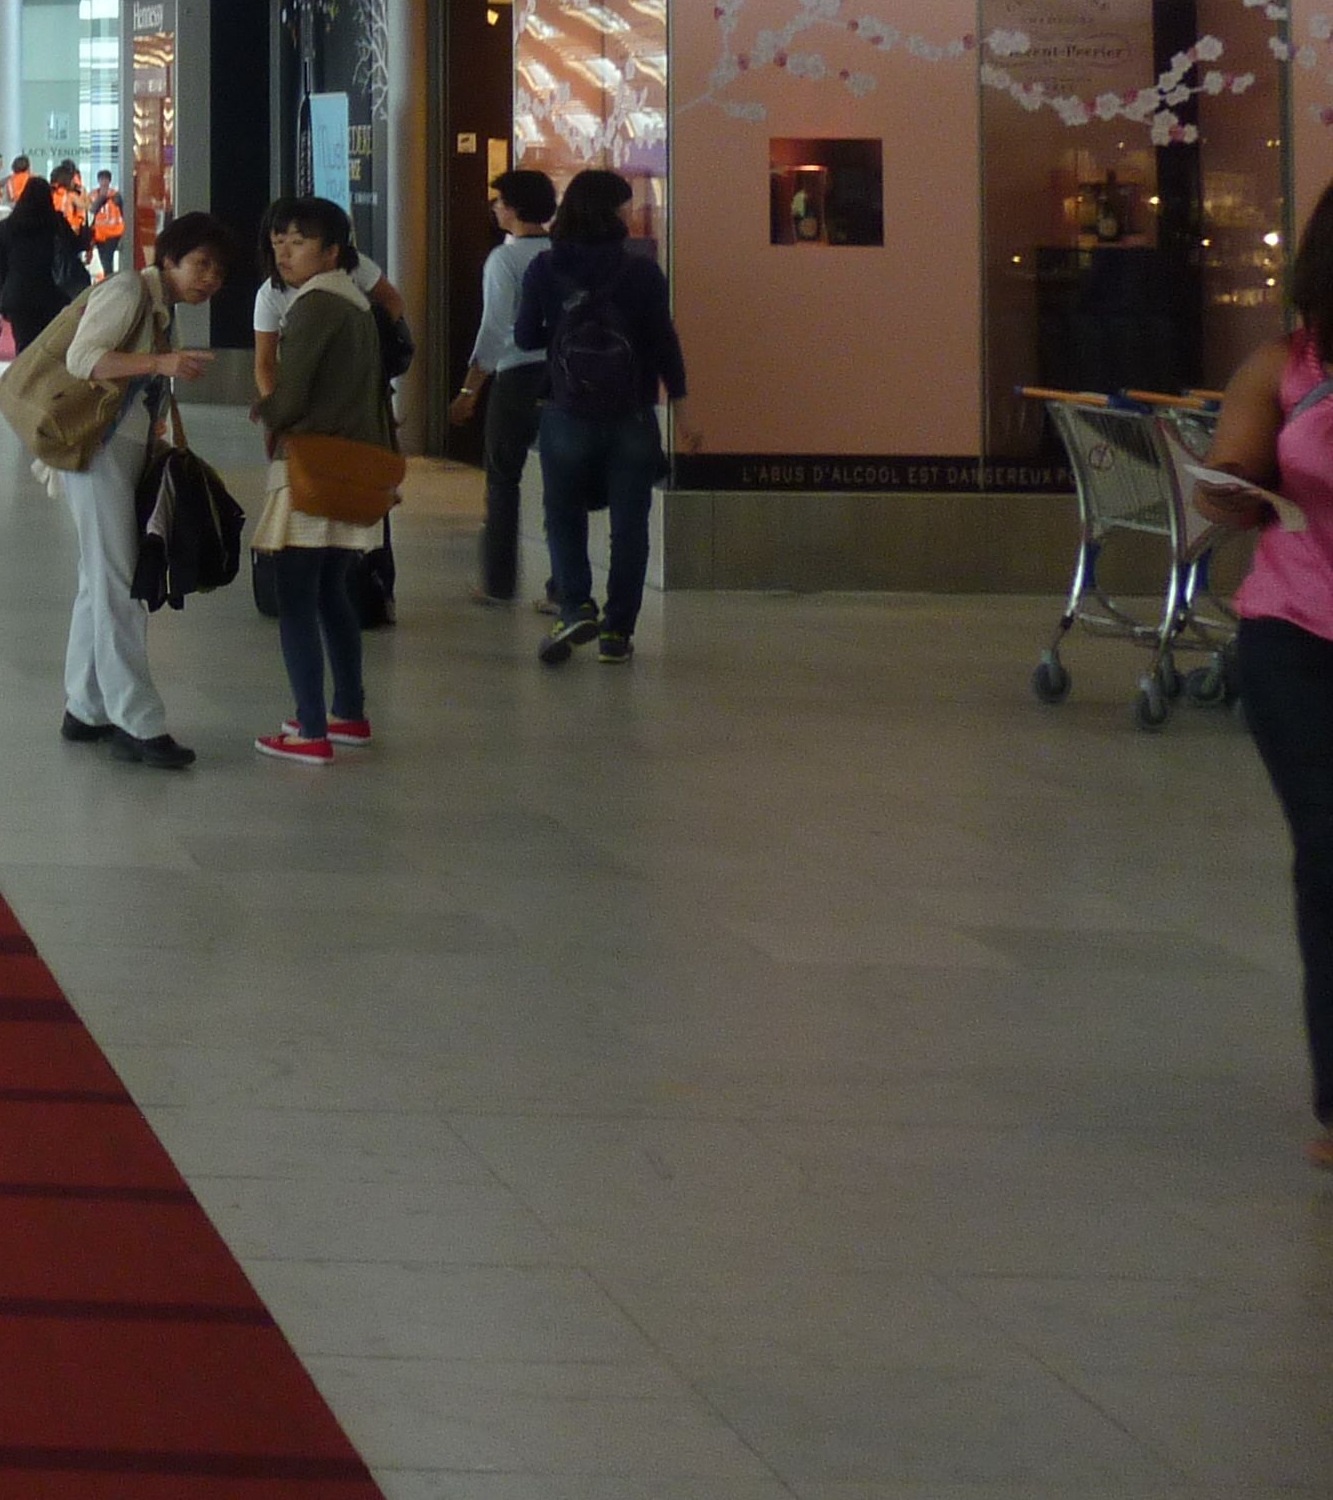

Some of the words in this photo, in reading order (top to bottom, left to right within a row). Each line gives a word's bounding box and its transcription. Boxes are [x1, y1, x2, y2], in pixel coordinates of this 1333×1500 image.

[742, 466, 804, 483] L'ABUS
[813, 466, 901, 483] D'ALCOOL
[908, 466, 938, 484] EST
[947, 466, 1051, 486] DANGEREUX
